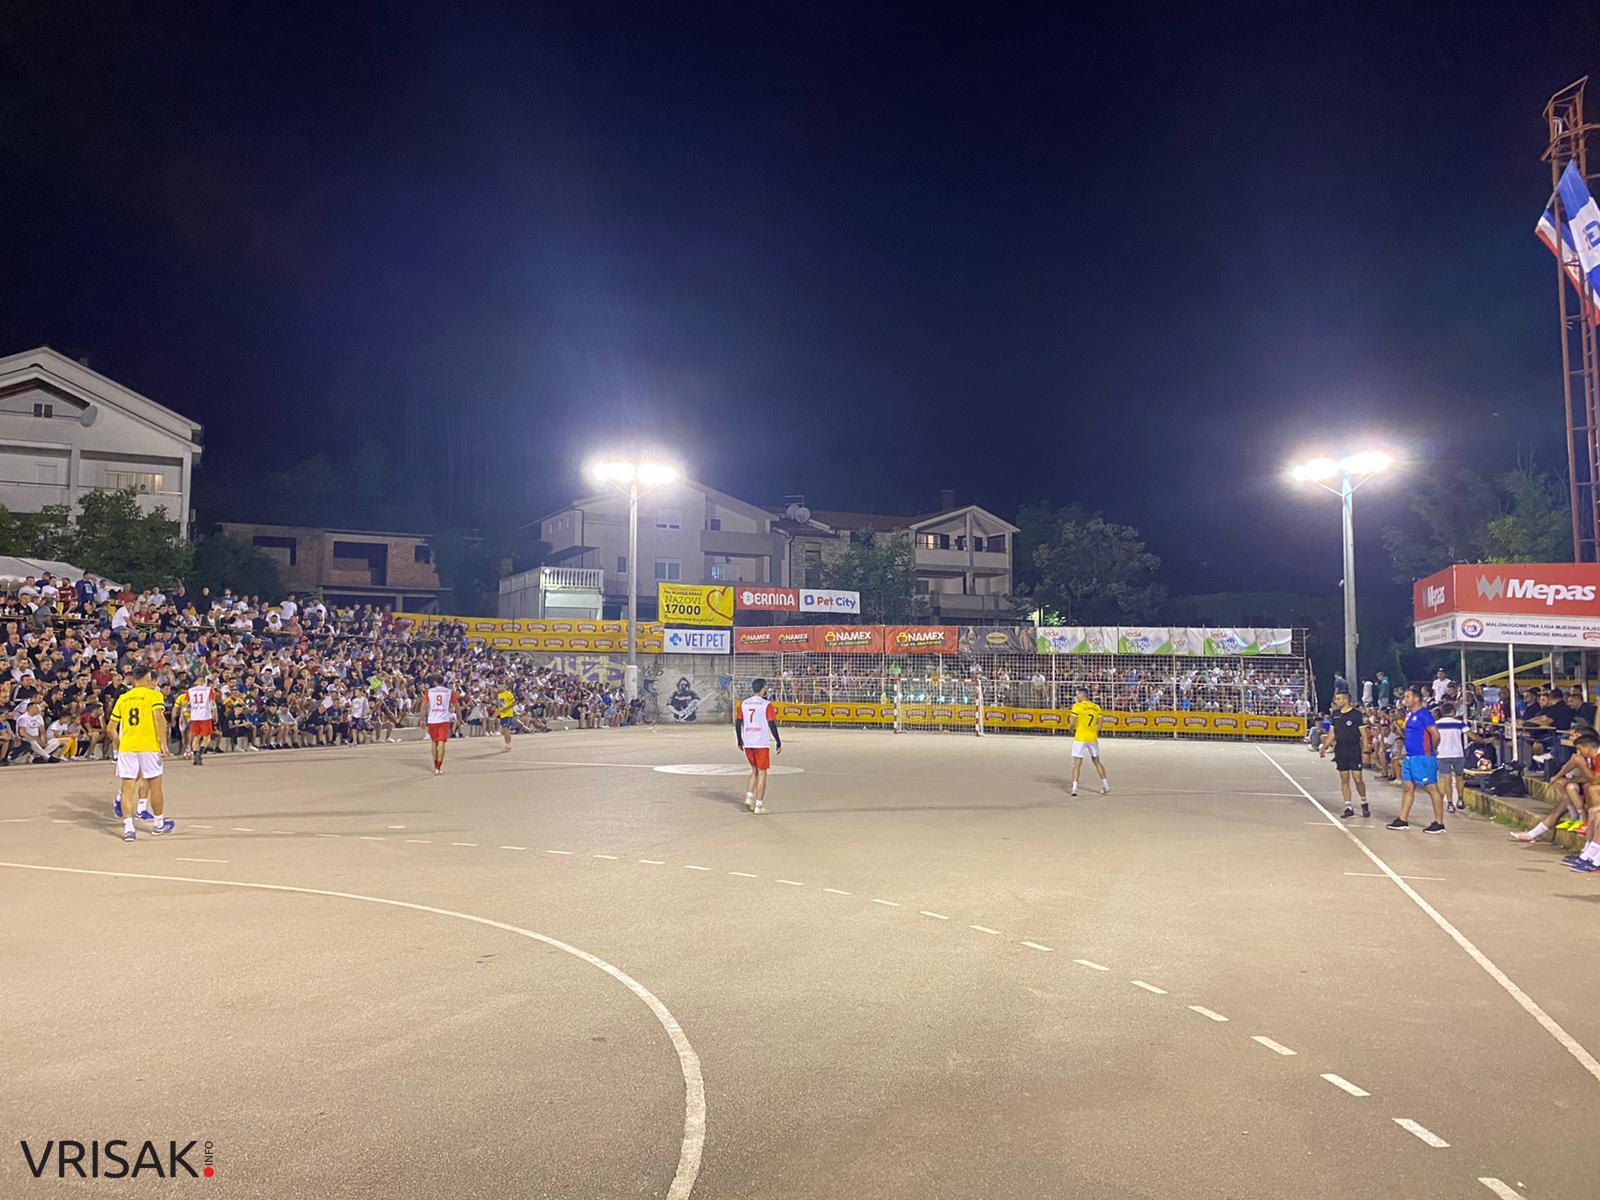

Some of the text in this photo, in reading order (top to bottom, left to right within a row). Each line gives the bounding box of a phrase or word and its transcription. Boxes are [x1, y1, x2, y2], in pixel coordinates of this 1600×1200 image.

[1506, 578, 1597, 606] Mepas
[664, 595, 702, 605] NAZOVI
[816, 596, 857, 609] Pet City
[664, 604, 701, 615] 17000
[685, 633, 725, 647] VET PET
[748, 633, 770, 641] NAMEX
[785, 633, 808, 641] NAMEX
[836, 631, 872, 641] NAMEX
[908, 631, 945, 642] NAMEX
[193, 693, 204, 704] 11
[436, 694, 443, 706] 9
[128, 707, 140, 726] 8
[748, 708, 756, 723] 7
[1088, 713, 1095, 727] 7
